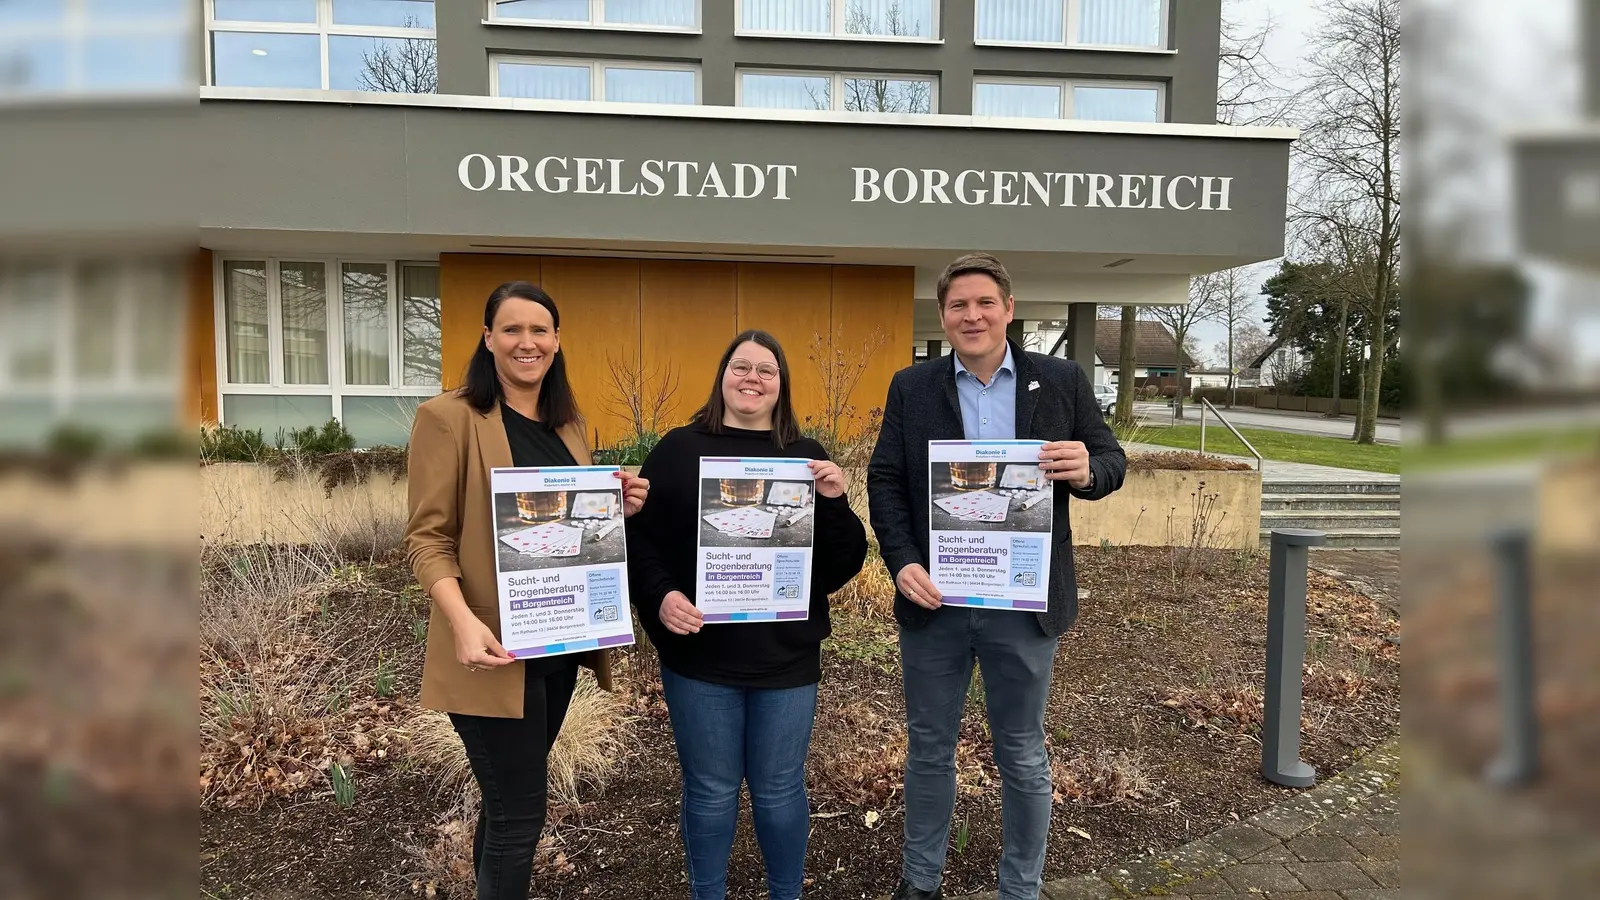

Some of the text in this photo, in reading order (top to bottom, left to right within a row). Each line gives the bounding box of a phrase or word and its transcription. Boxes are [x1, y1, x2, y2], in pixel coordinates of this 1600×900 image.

[458, 153, 1233, 211] ORGELSTADT BORGENTREICH
[938, 536, 984, 544] Sucht- und
[938, 546, 1008, 556] Drogenberatung
[706, 552, 751, 560] Sucht- und
[706, 562, 772, 571] Drogenberatung
[508, 574, 560, 586] Sucht- und
[717, 573, 761, 581] Borgentreich
[509, 584, 585, 598] Drogenberatung
[522, 597, 573, 608] Borgentreich
[553, 607, 585, 615] Donnerstag
